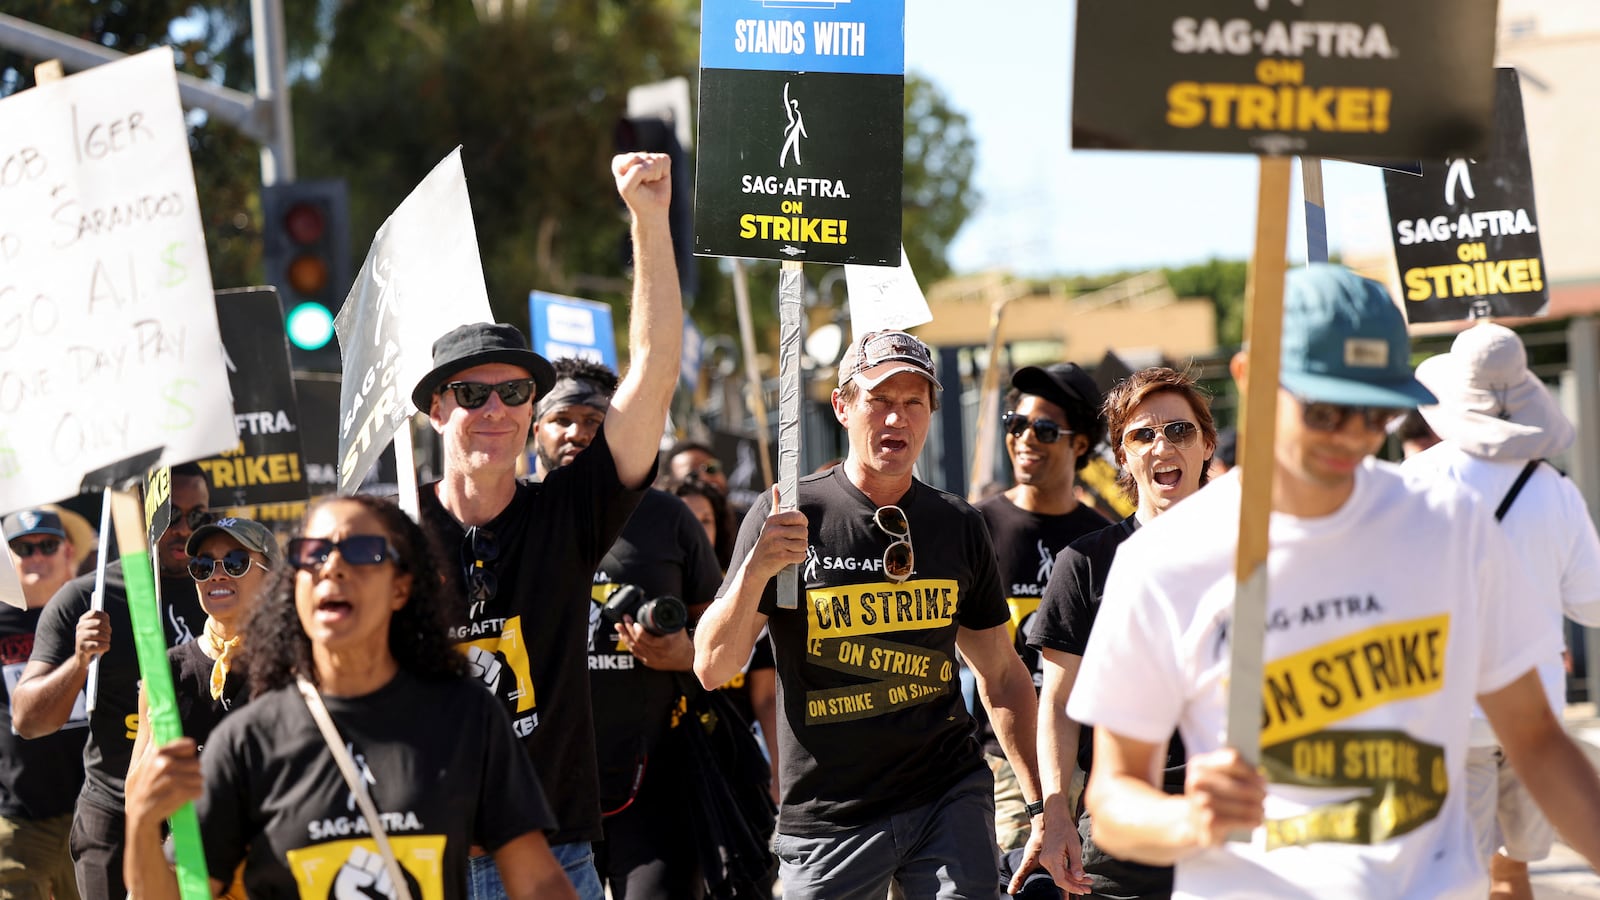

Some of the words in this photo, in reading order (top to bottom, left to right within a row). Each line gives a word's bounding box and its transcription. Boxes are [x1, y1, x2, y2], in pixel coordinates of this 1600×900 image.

[735, 19, 805, 54] STANDS
[813, 21, 865, 56] WITH
[1255, 59, 1304, 85] ON
[1166, 81, 1392, 133] STRIKE!
[0, 147, 48, 186] OB
[71, 103, 155, 164] IGER
[781, 200, 803, 215] ON
[740, 213, 848, 245] STRIKE!
[1457, 242, 1487, 263] ON
[1404, 258, 1544, 302] STRIKE!
[66, 343, 128, 385] DAY
[132, 317, 188, 366] PAY
[815, 594, 852, 630] ON
[860, 588, 952, 626] STRIKE
[838, 640, 866, 668] ON
[868, 647, 931, 679] STRIKE
[1310, 628, 1442, 710] STRIKE
[808, 699, 828, 718] ON
[828, 692, 874, 716] STRIKE
[888, 684, 908, 706] ON
[1292, 739, 1336, 780] ON
